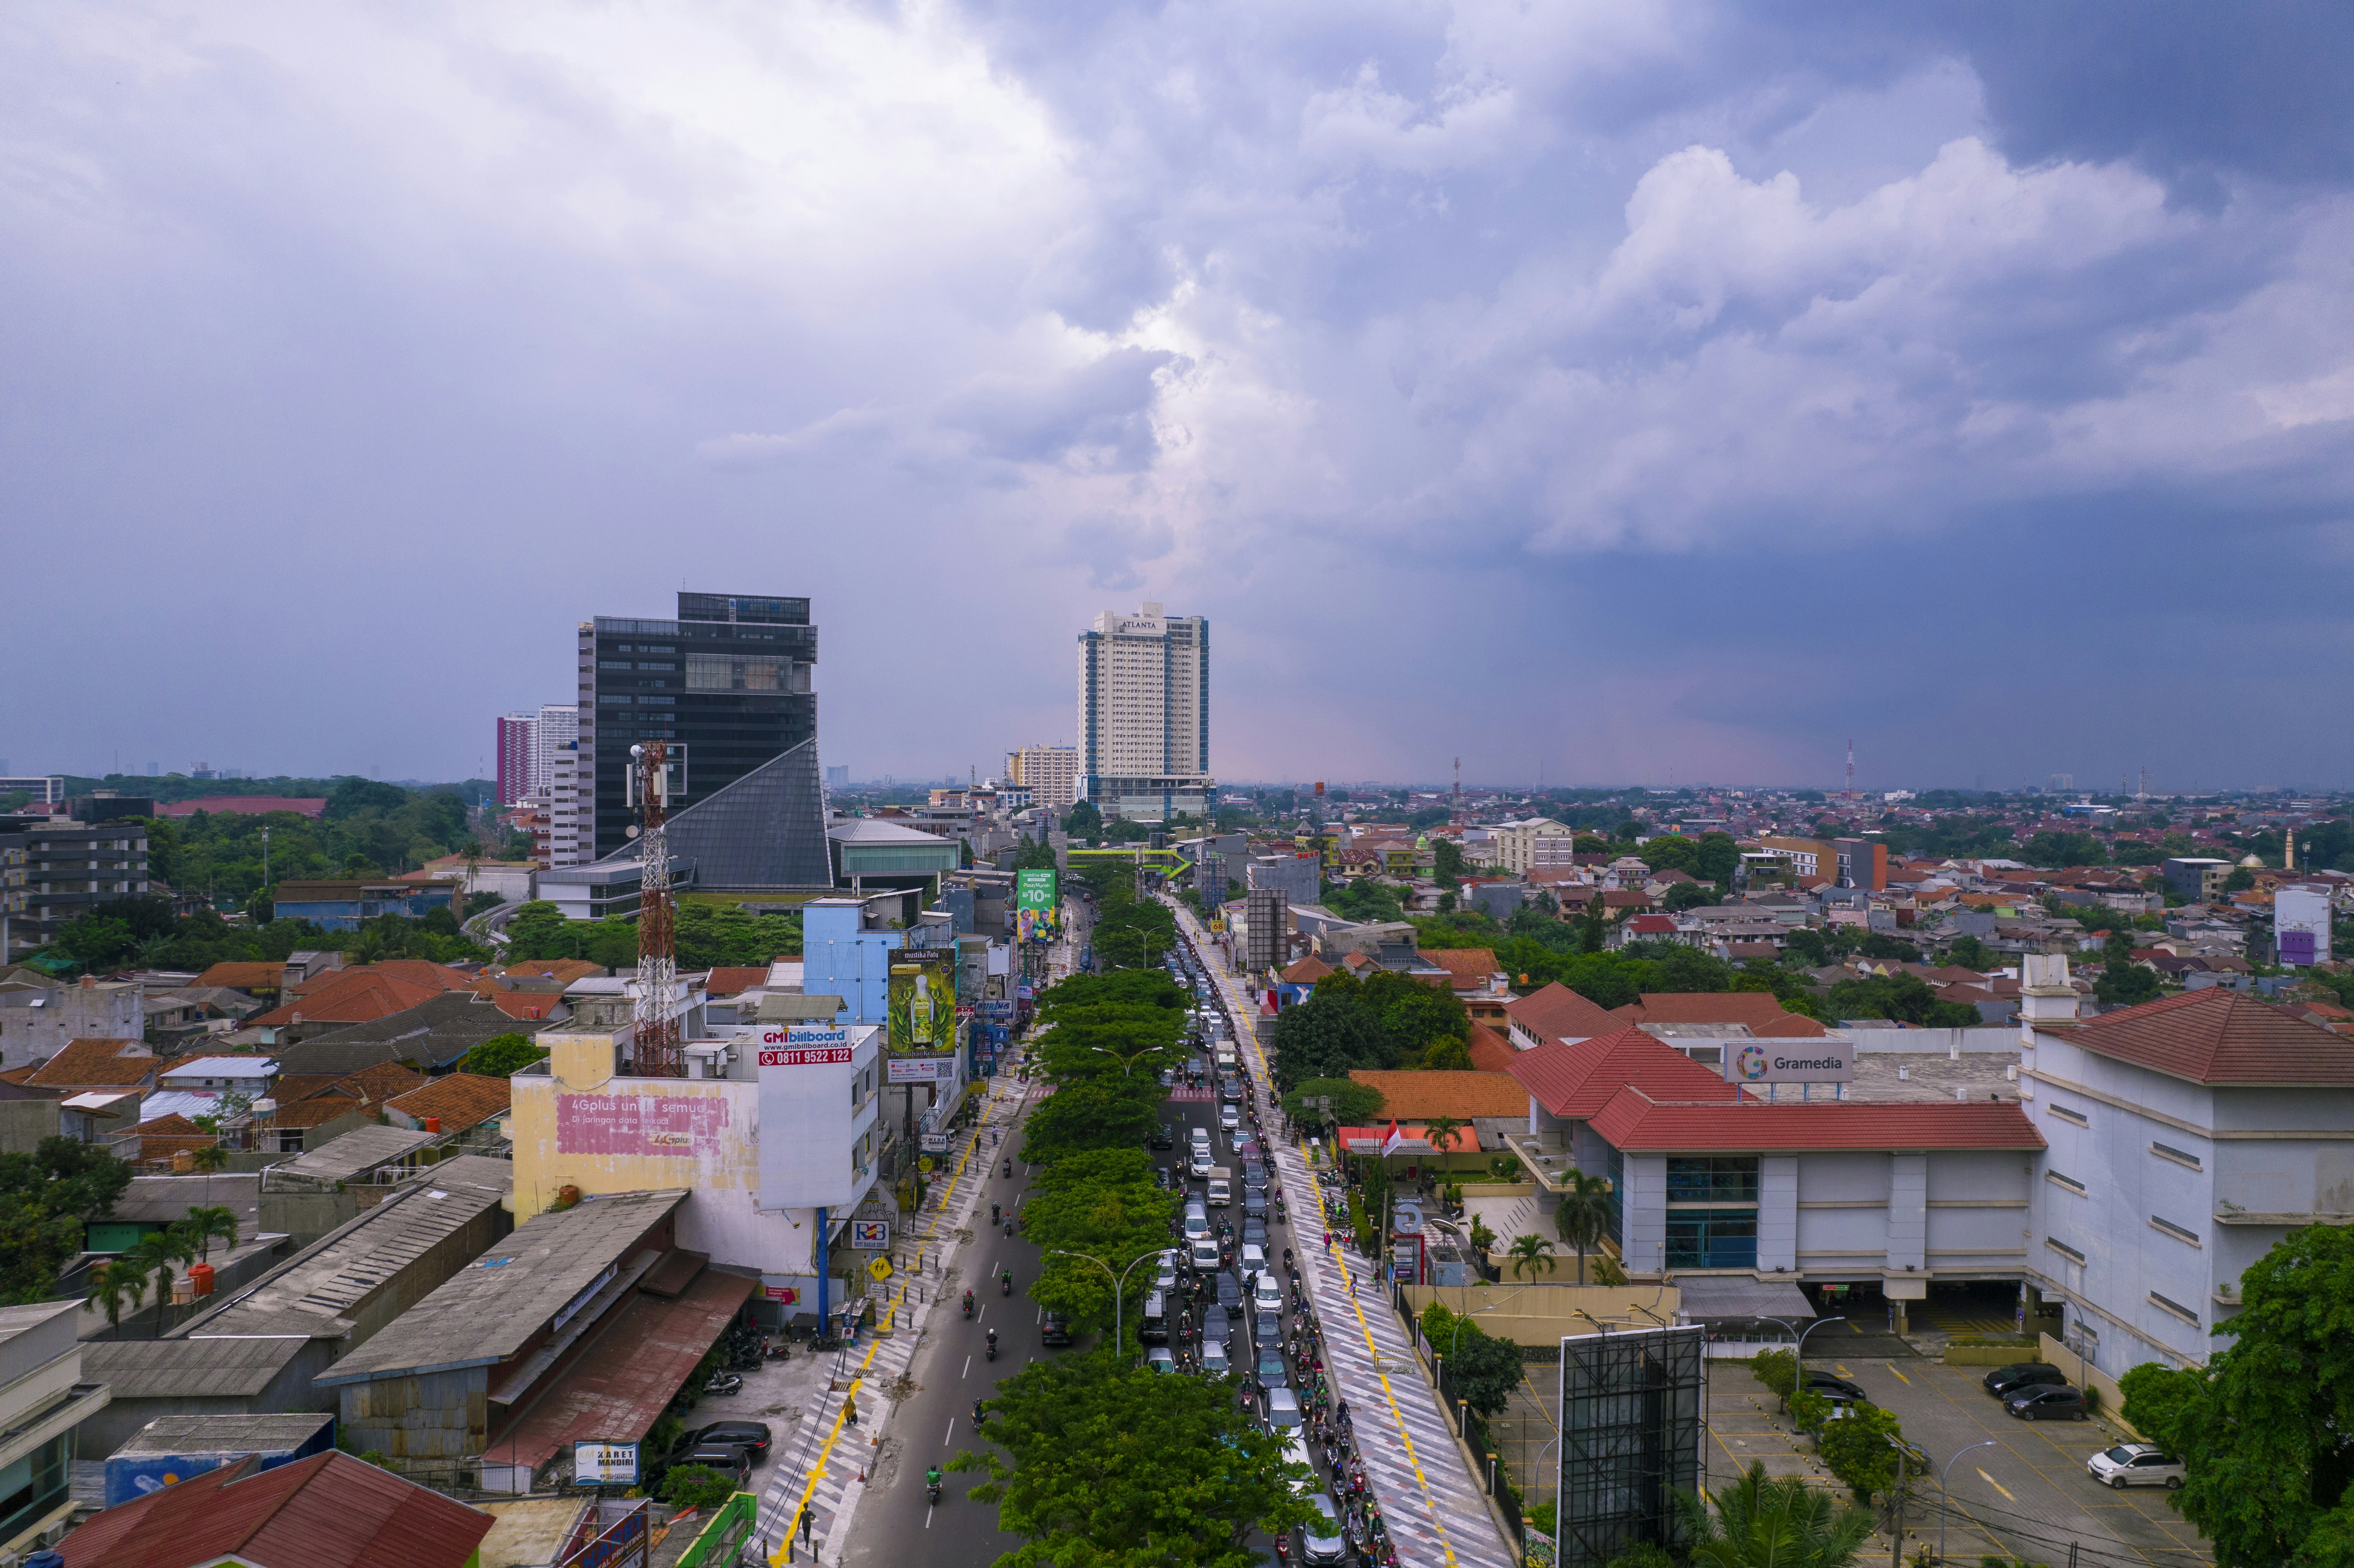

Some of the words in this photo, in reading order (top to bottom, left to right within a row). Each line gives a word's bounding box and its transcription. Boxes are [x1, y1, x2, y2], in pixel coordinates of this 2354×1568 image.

[1028, 890, 1044, 902] 10
[763, 1030, 845, 1043] GMIbillboard
[764, 1041, 847, 1050] www.gmibillboard.co.id
[777, 1052, 800, 1064] 0811
[804, 1050, 828, 1063] 9522
[832, 1049, 849, 1061] 122
[1774, 1057, 1842, 1069] Gramedia
[572, 1100, 616, 1112] 4Gplus
[662, 1103, 707, 1113] semua
[582, 1116, 616, 1125] jaringan
[654, 1133, 692, 1146] 4Gplus
[931, 1174, 941, 1182] 24
[583, 1511, 644, 1568] KARET
[612, 1530, 645, 1561] PRINTING
